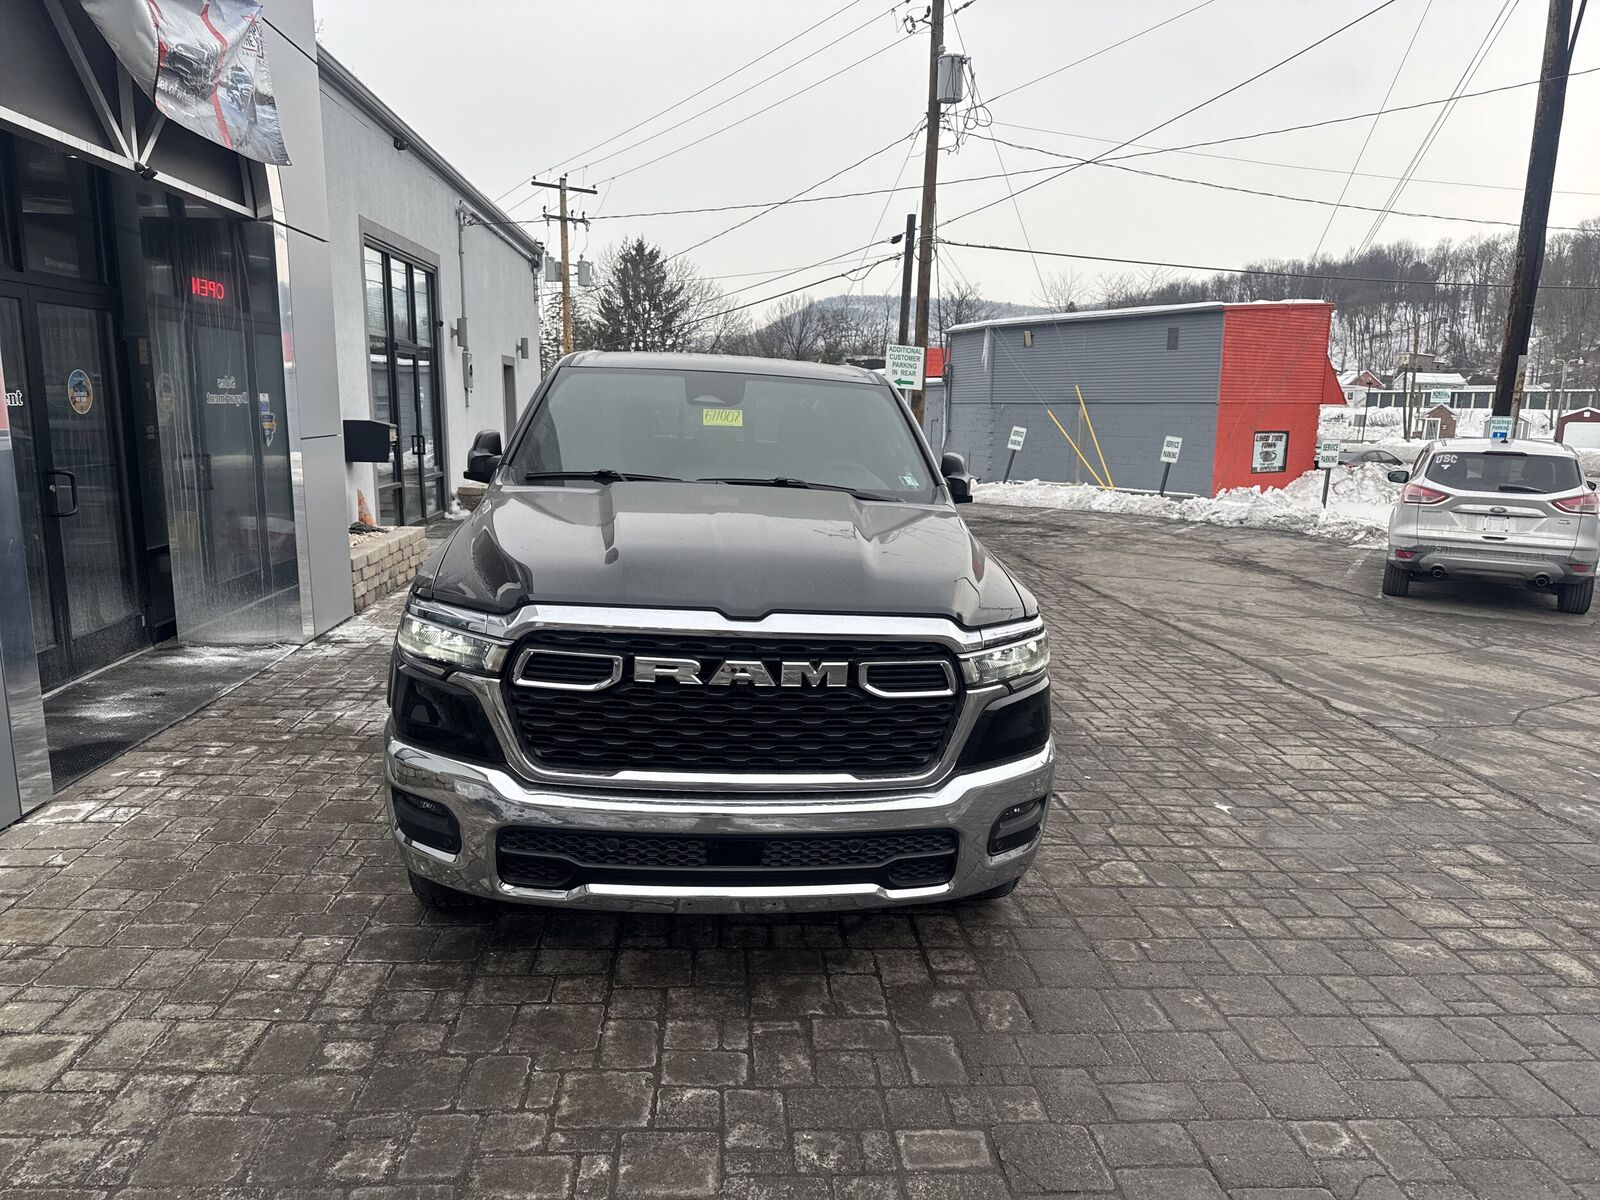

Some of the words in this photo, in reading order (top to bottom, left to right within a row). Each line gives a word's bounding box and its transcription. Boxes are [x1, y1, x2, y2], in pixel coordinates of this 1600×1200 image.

[888, 346, 922, 354] ADDITIONAL
[889, 353, 921, 362] CUSTOMER
[892, 362, 917, 370] PARKING
[1164, 440, 1180, 449] SERVICE
[1322, 443, 1339, 452] SERVICE
[1320, 455, 1338, 463] PARKING
[1435, 454, 1458, 464] USC
[634, 656, 849, 687] RAM
